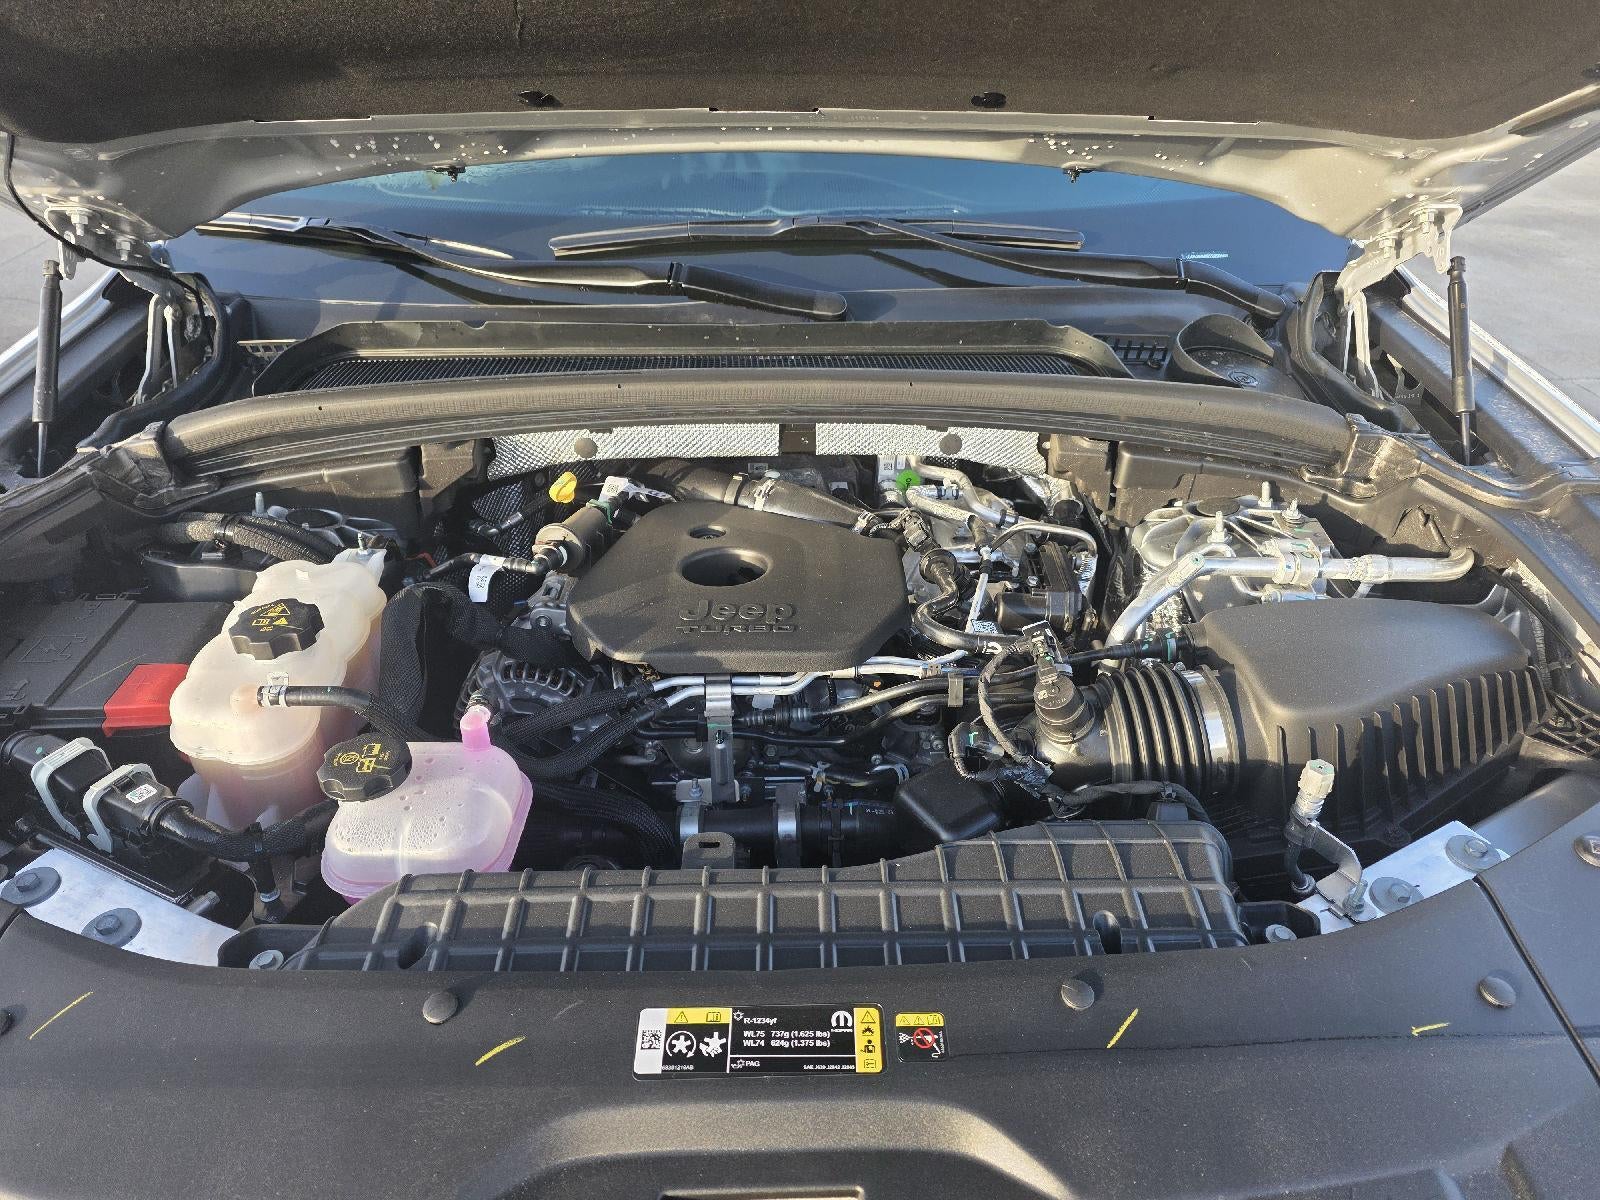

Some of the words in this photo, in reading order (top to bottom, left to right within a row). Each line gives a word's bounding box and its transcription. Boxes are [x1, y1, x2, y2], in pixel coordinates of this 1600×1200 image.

[678, 599, 796, 625] Jeep
[675, 624, 797, 634] TURBO
[743, 1017, 777, 1026] R-1234yf
[743, 1030, 766, 1038] WL75
[770, 1030, 790, 1039] 737g
[790, 1030, 815, 1039] (1.625
[815, 1030, 831, 1039] lbs)
[742, 1039, 765, 1047] WL74
[770, 1039, 790, 1048] 624g
[790, 1039, 815, 1048] (1.375
[815, 1039, 831, 1048] lbs)
